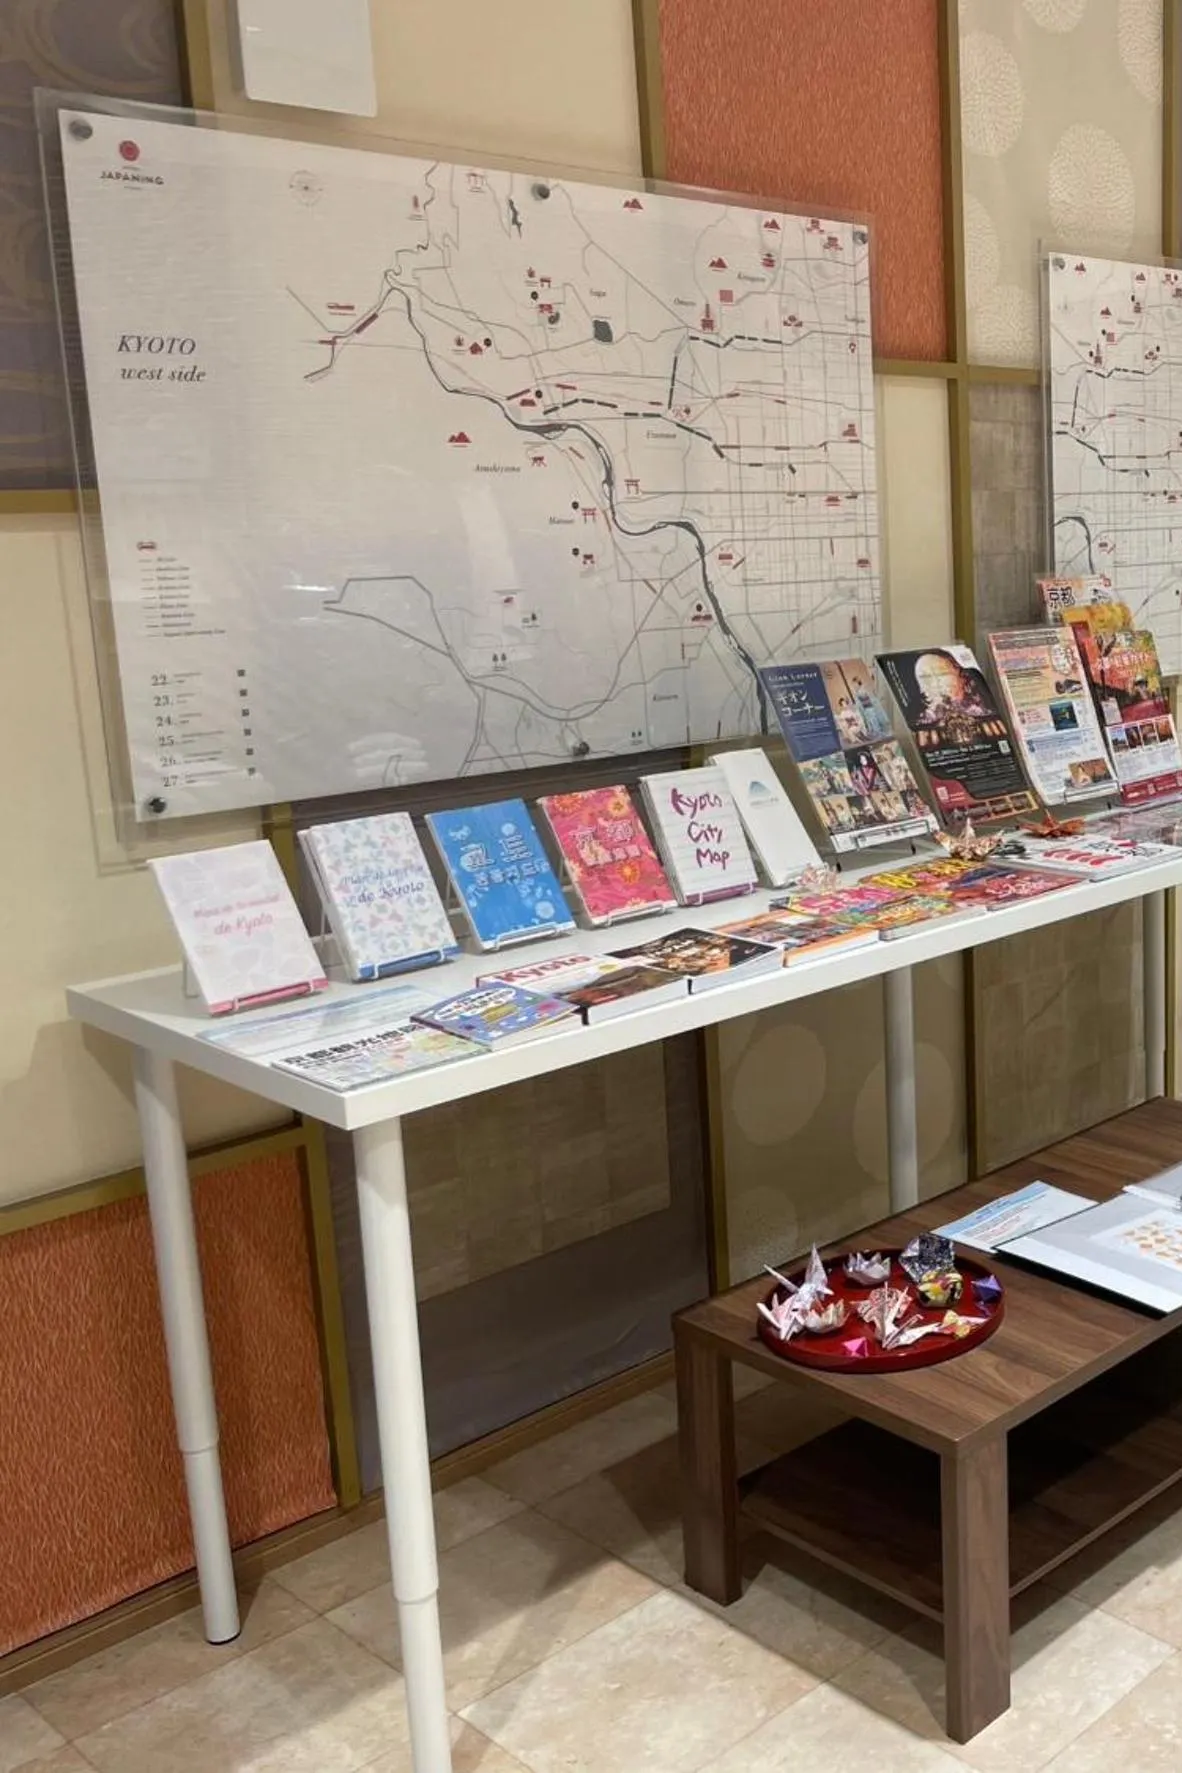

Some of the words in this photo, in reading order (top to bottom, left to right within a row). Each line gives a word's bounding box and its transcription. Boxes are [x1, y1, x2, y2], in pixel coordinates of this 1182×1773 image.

[117, 334, 197, 356] KYOTO
[120, 367, 163, 381] west
[167, 364, 207, 382] side
[781, 702, 825, 718] コーナー
[670, 788, 723, 819] Kyoto
[687, 821, 724, 844] City
[696, 847, 730, 871] Map
[495, 956, 592, 982] Kyoto
